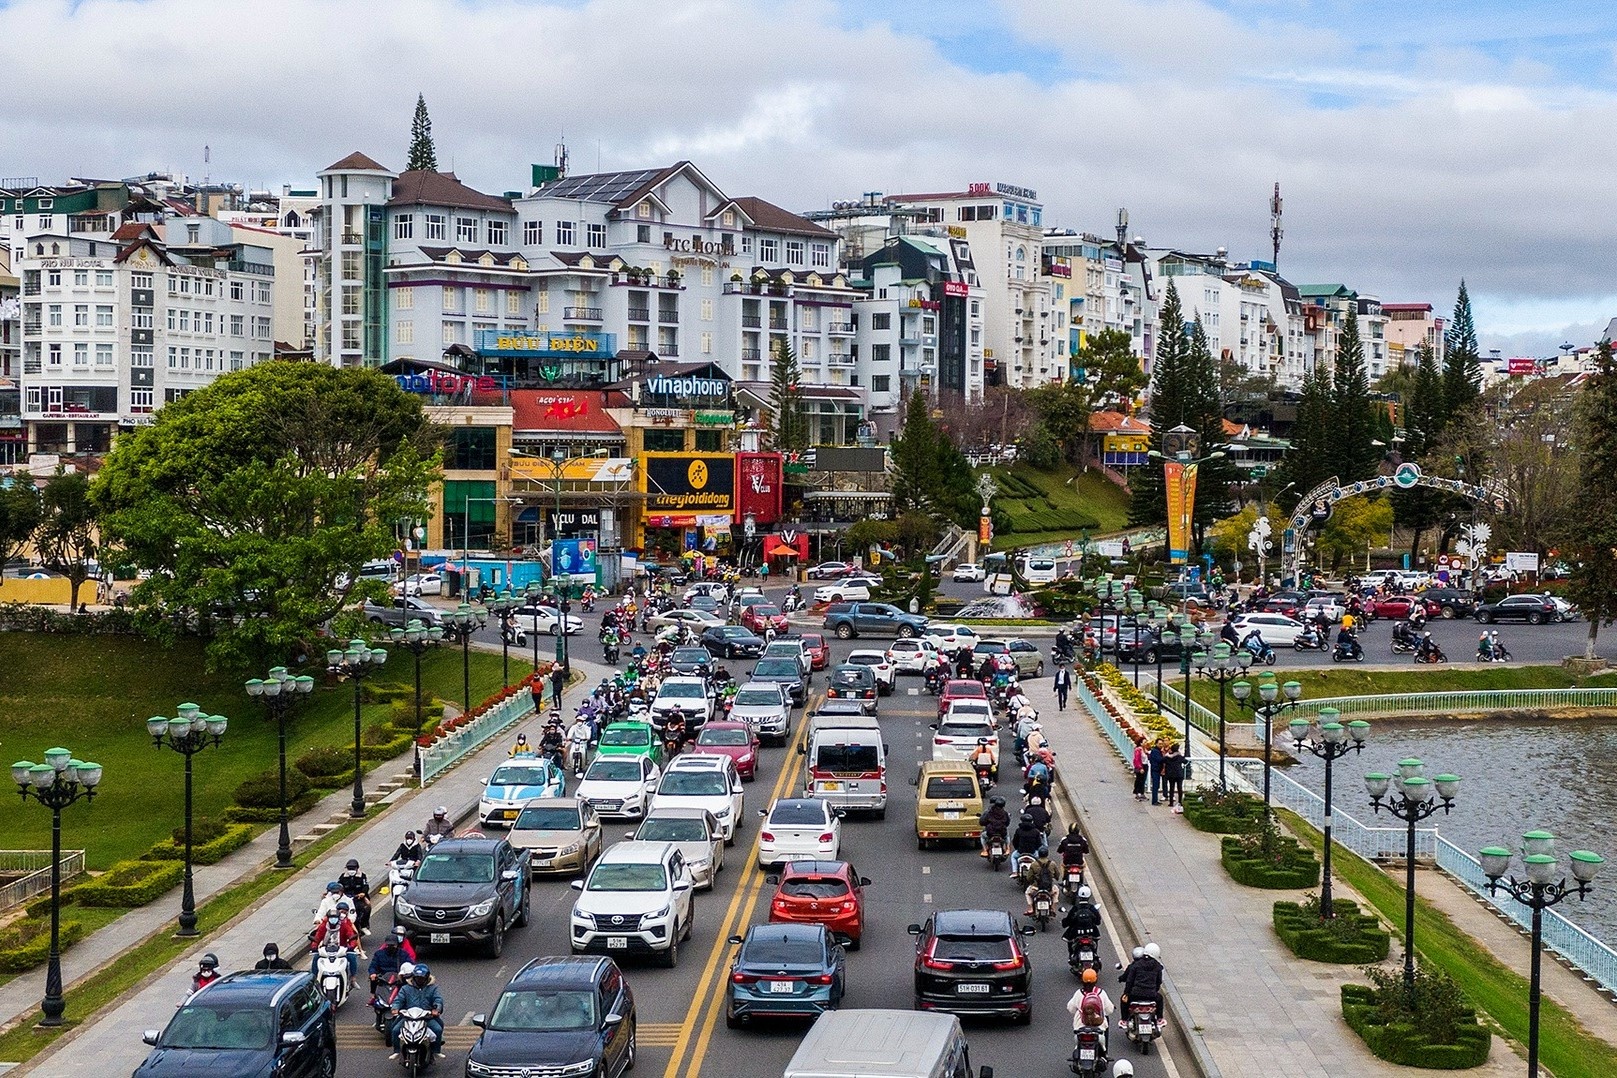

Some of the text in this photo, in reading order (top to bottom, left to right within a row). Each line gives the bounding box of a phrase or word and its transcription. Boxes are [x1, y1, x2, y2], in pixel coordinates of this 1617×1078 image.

[969, 183, 990, 192] 500K
[694, 241, 738, 257] HOTEL
[77, 259, 105, 268] HOTEL
[496, 335, 598, 353] BƯU ĐIỆN
[647, 374, 723, 397] vinaphone
[656, 492, 730, 508] thegioididong
